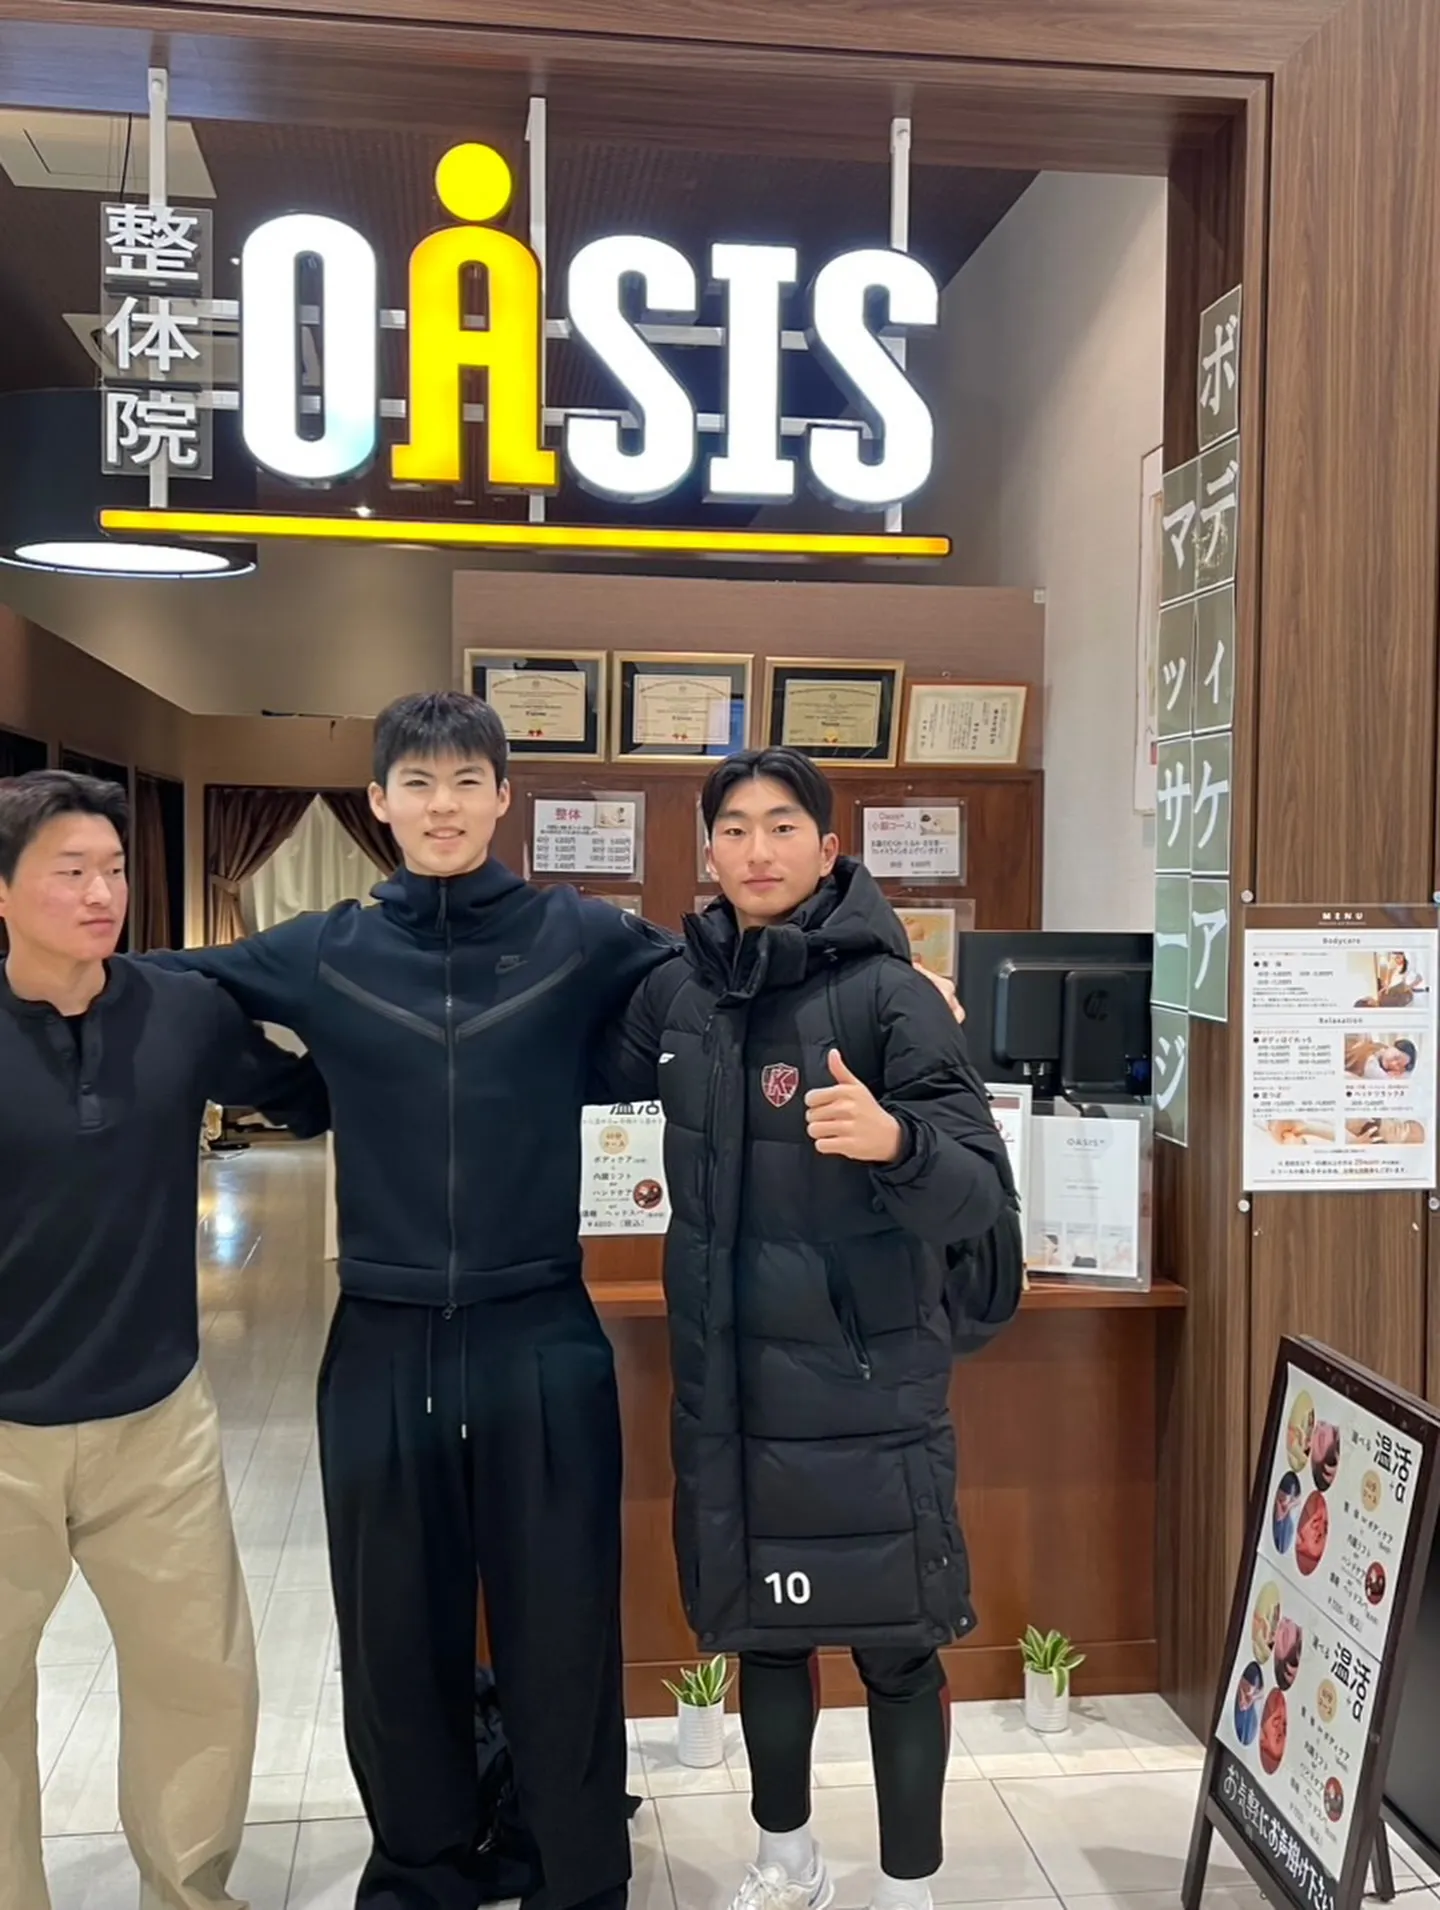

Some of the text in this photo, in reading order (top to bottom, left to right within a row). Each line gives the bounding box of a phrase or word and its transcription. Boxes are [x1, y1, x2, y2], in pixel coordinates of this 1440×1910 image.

[106, 204, 201, 465] 整体院
[241, 212, 939, 504] OASIS
[1192, 313, 1239, 990] ボディケア
[554, 807, 582, 821] 整体
[1155, 498, 1197, 1111] マッサージ
[1321, 912, 1364, 920] MENU
[1322, 937, 1361, 946] Bodycare
[767, 1068, 794, 1096] K
[1375, 1429, 1413, 1482] 温活
[763, 1570, 811, 1605] 10
[1330, 1641, 1371, 1700] 温活
